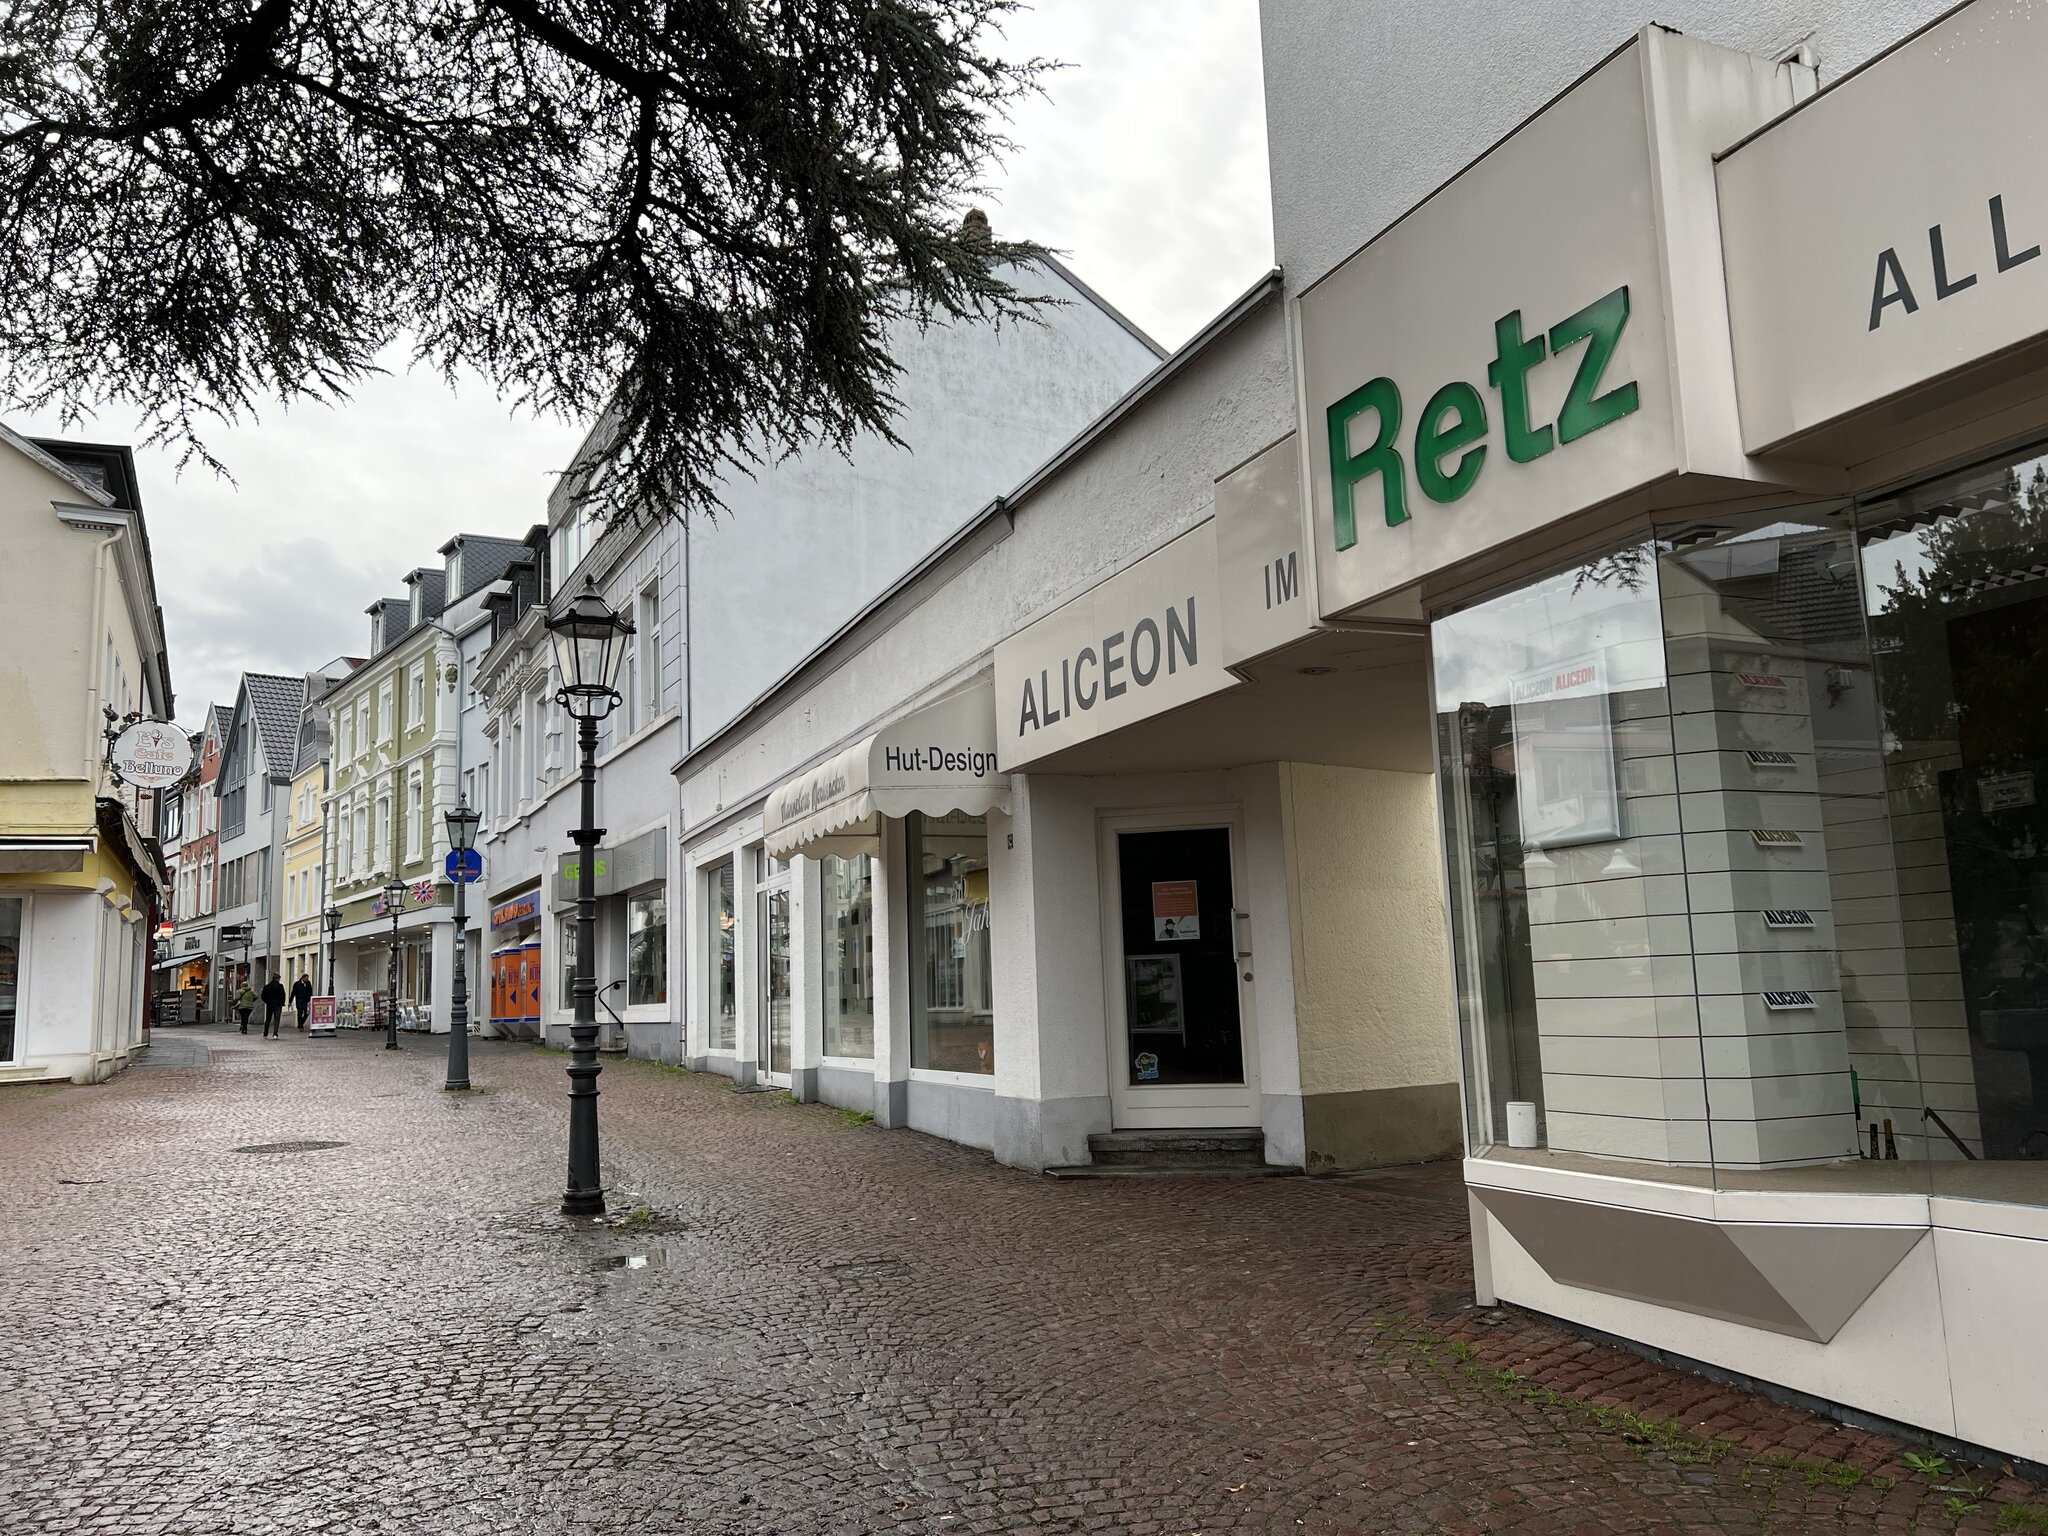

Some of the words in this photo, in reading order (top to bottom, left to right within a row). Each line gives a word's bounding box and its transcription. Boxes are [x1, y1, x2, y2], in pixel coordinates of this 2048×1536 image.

[1868, 193, 2042, 333] ALL
[1326, 284, 1640, 552] Retz
[1264, 551, 1299, 610] IM
[1018, 595, 1199, 738] ALICEON
[1555, 665, 1596, 692] ALICEON
[122, 760, 184, 776] Belluno
[885, 745, 998, 778] Hut-Design
[1763, 910, 1814, 925] ALICEON
[1763, 991, 1815, 1006] ALICEON
